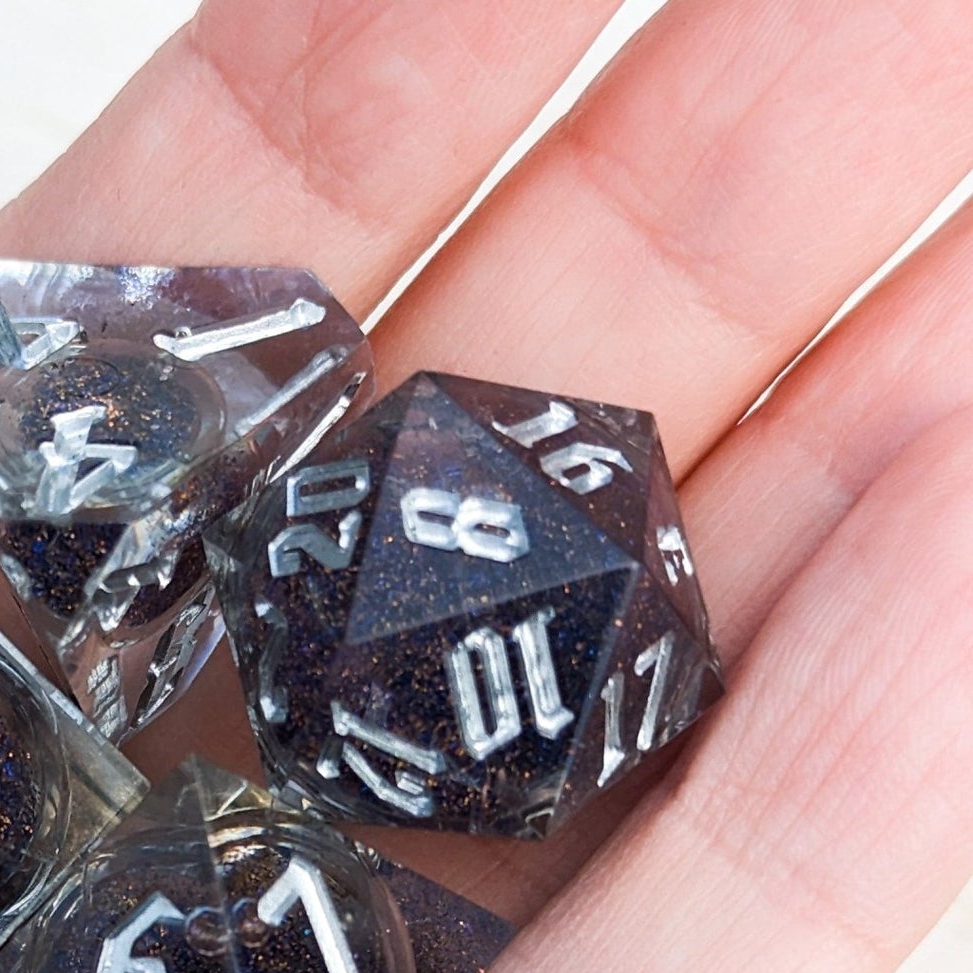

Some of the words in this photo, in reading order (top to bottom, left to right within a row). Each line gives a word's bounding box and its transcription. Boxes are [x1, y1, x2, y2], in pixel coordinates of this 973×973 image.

[492, 401, 632, 494] 16
[268, 459, 370, 578] 20
[400, 488, 530, 563] 8
[446, 606, 574, 760] 10
[601, 630, 675, 787] 17
